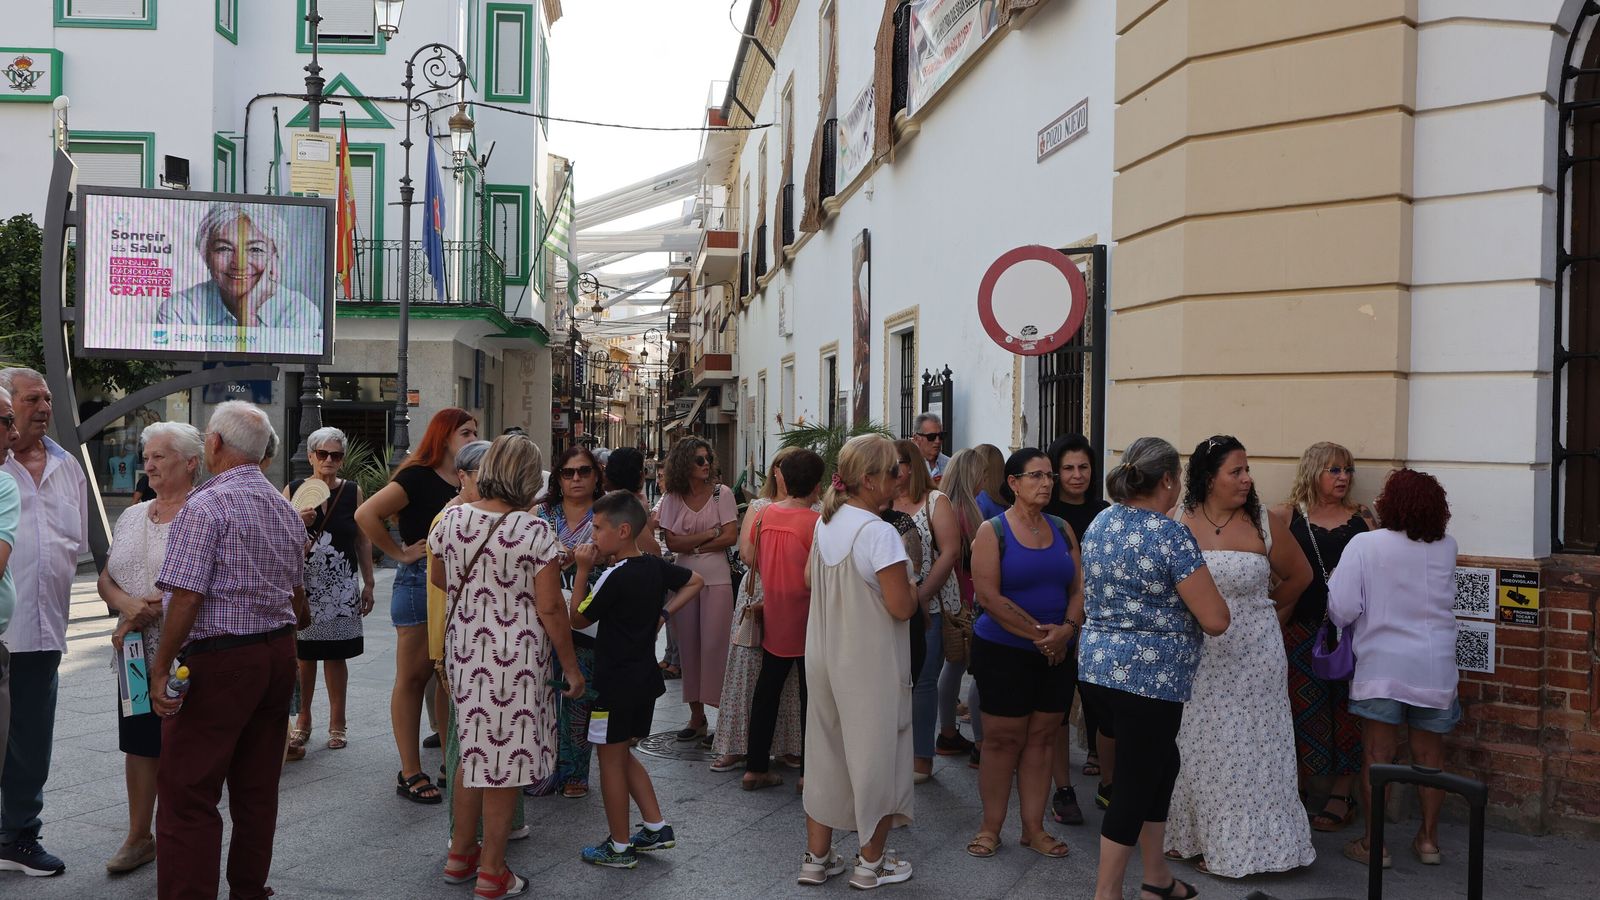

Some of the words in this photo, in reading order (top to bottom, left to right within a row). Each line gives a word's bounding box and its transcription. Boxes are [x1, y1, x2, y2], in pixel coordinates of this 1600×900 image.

[1045, 123, 1062, 150] POZO
[111, 229, 166, 242] Sonreir
[130, 243, 172, 254] Salud
[109, 285, 171, 298] GRATIS
[174, 333, 208, 343] DENTAL
[210, 334, 257, 345] COMPANY
[227, 385, 246, 393] 1926
